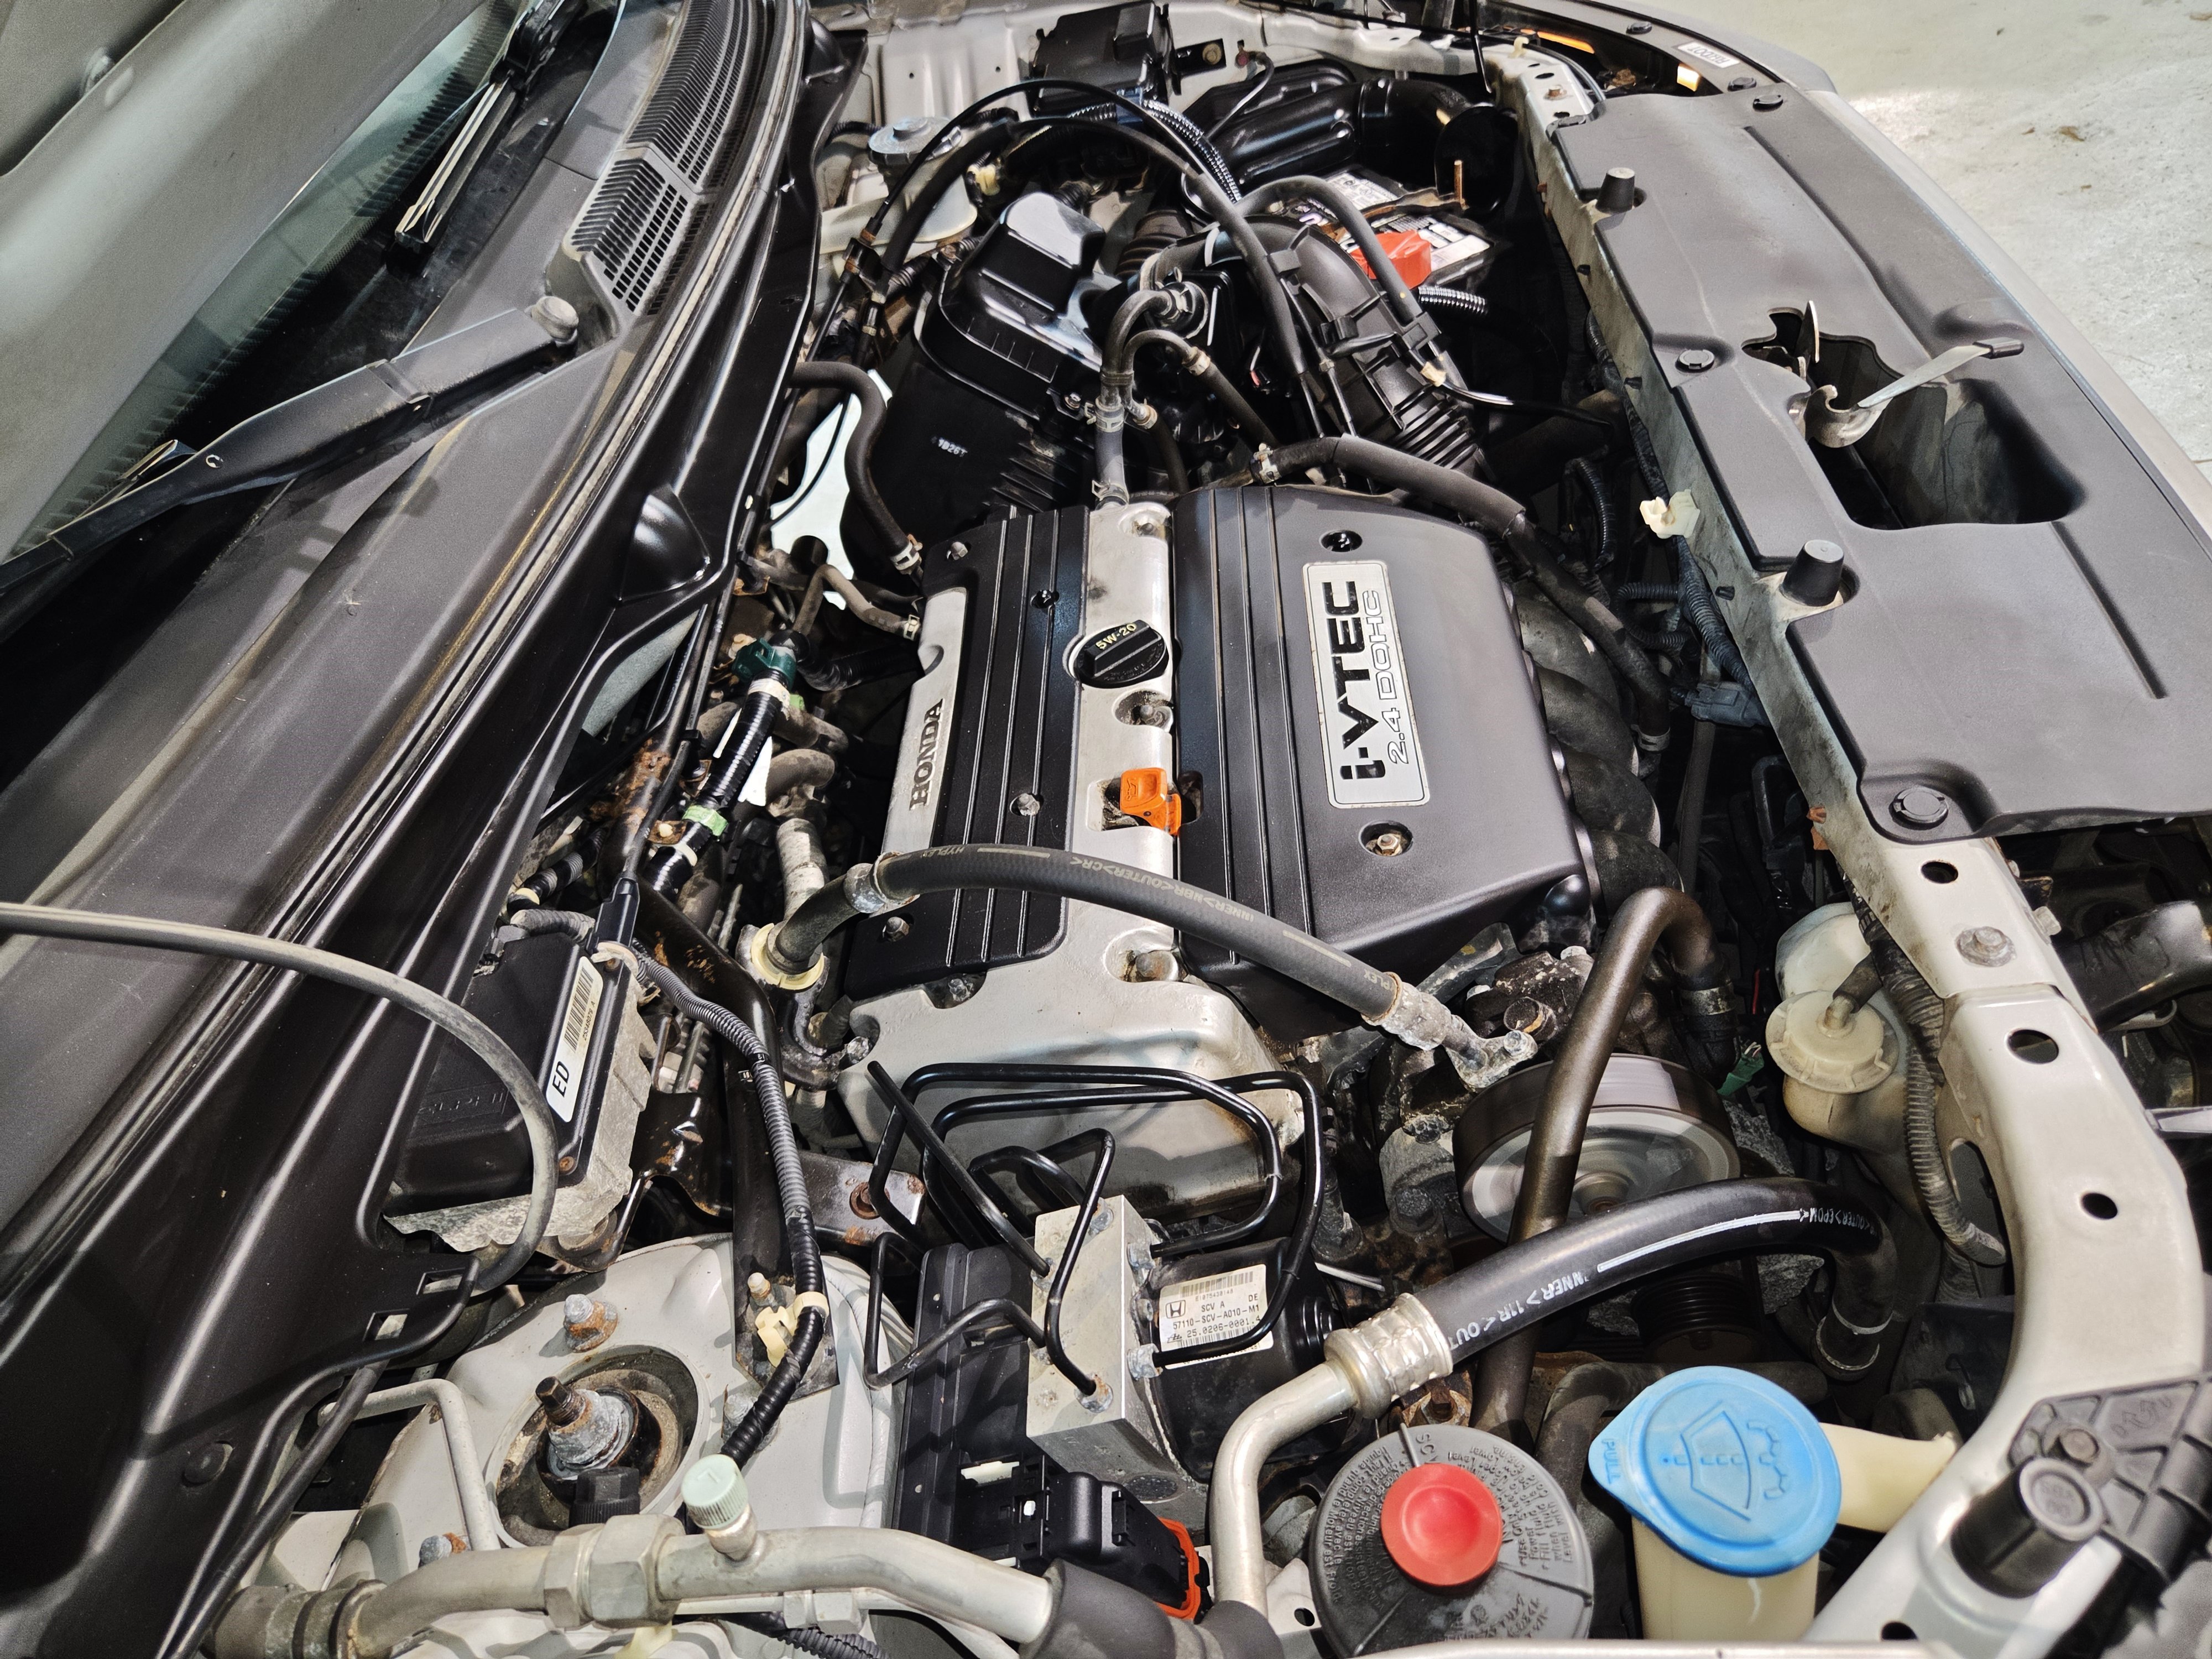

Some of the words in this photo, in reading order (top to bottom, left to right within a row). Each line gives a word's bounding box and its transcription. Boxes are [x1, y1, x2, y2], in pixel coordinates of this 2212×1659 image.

[1094, 622, 1138, 650] 5W-20
[1363, 590, 1397, 700] DOHC
[1322, 581, 1386, 780] i-VTEC
[909, 699, 945, 810] HONDA
[1380, 708, 1410, 764] 2.4
[552, 1061, 570, 1098] ED
[1173, 1305, 1260, 1330] 57110-SCV-A010-M1
[1201, 1303, 1215, 1313] SCV
[1248, 1293, 1259, 1302] DE
[1601, 1438, 1618, 1485] PULL
